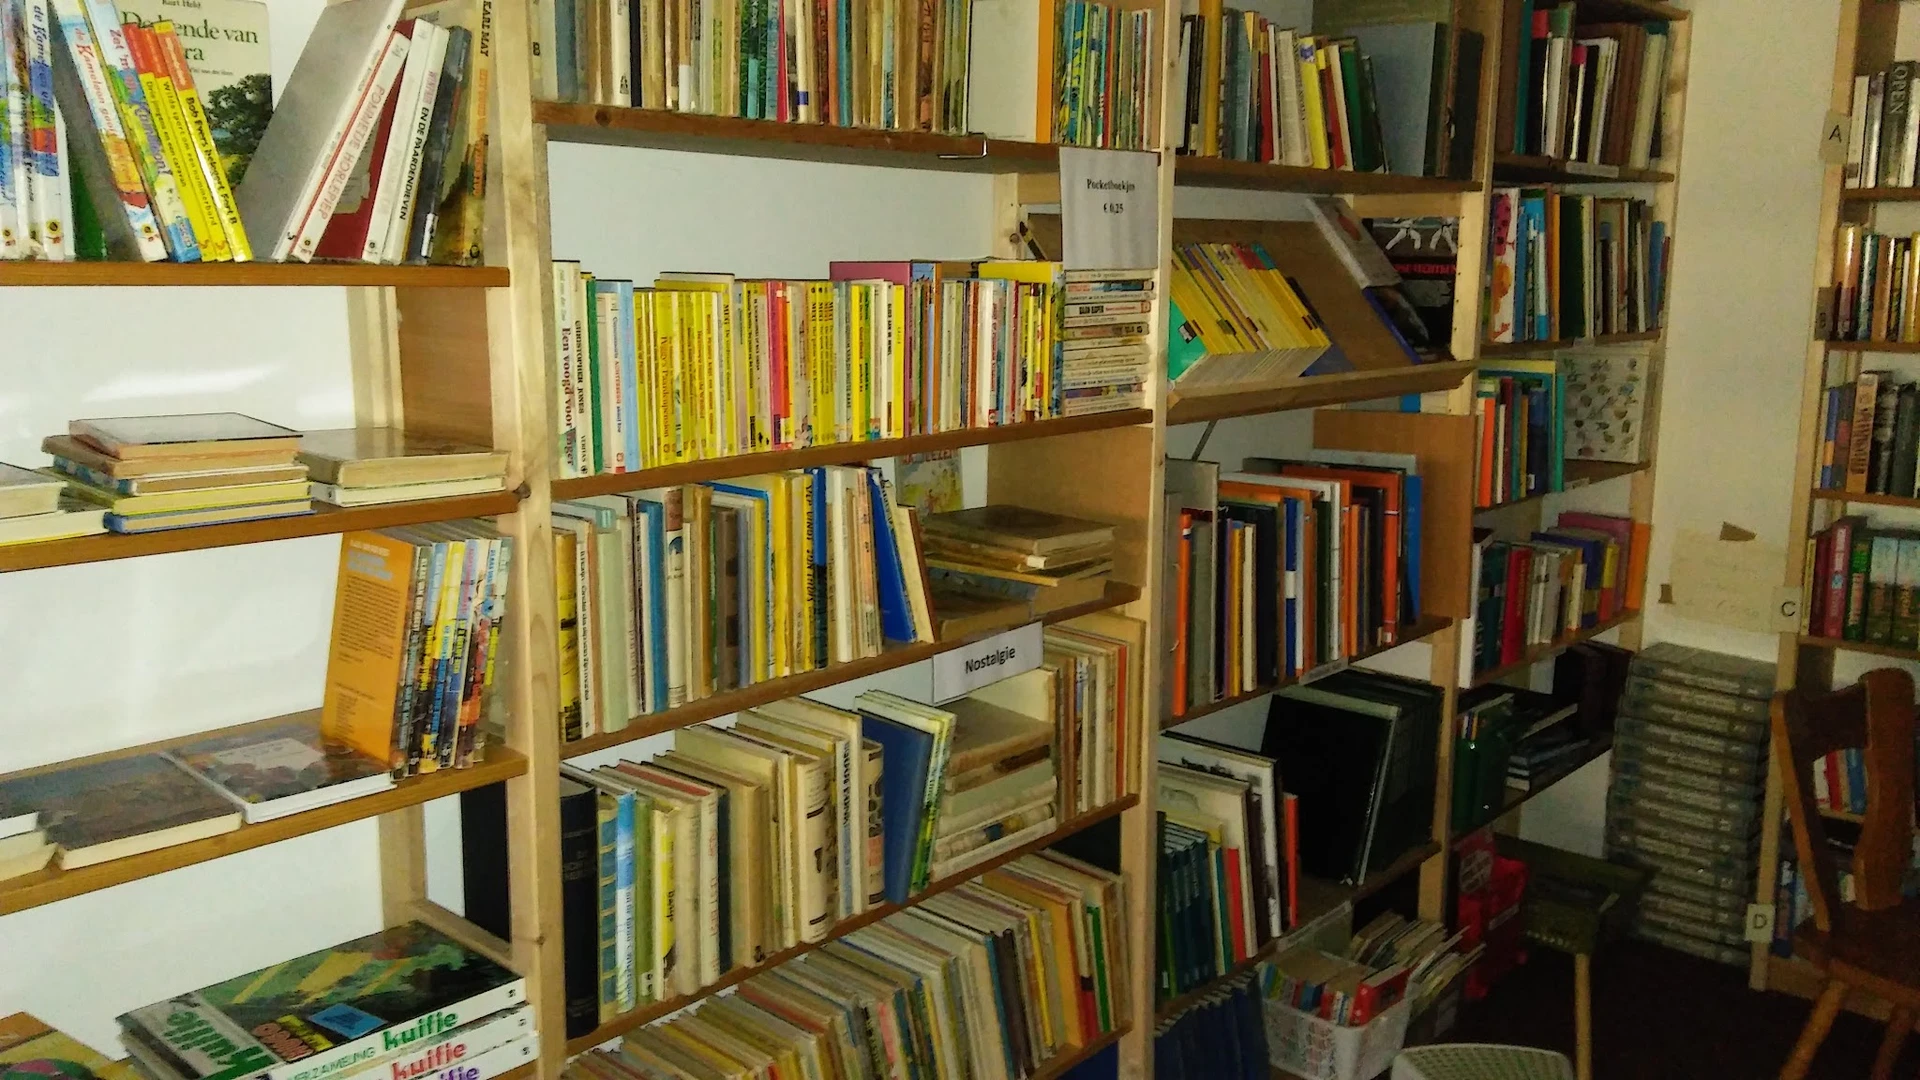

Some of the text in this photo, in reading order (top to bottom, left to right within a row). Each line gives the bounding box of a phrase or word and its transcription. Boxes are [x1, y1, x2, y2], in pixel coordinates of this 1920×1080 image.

[223, 28, 258, 44] van
[479, 0, 492, 57] KARL MAY
[76, 44, 105, 106] Kameleon
[1894, 65, 1909, 115] OPEN
[185, 96, 200, 118] Bob
[193, 119, 210, 147] Evers
[416, 122, 425, 135] DE
[419, 106, 429, 121] EN
[1828, 124, 1842, 143] A
[171, 156, 188, 188] caravan
[398, 136, 422, 221] PAARDENDIEVEN
[561, 327, 572, 351] Een
[559, 354, 574, 395] voogd
[574, 320, 585, 413] CHRISTOPHER JONES
[564, 398, 574, 428] voor
[660, 369, 670, 437] Paardenpension
[1781, 601, 1796, 617] C
[965, 646, 1016, 675] Nostalgie
[1753, 913, 1768, 930] D
[285, 1046, 377, 1080] ERZAMELING
[383, 1011, 459, 1051] kuifje
[392, 1042, 467, 1080] kuifje
